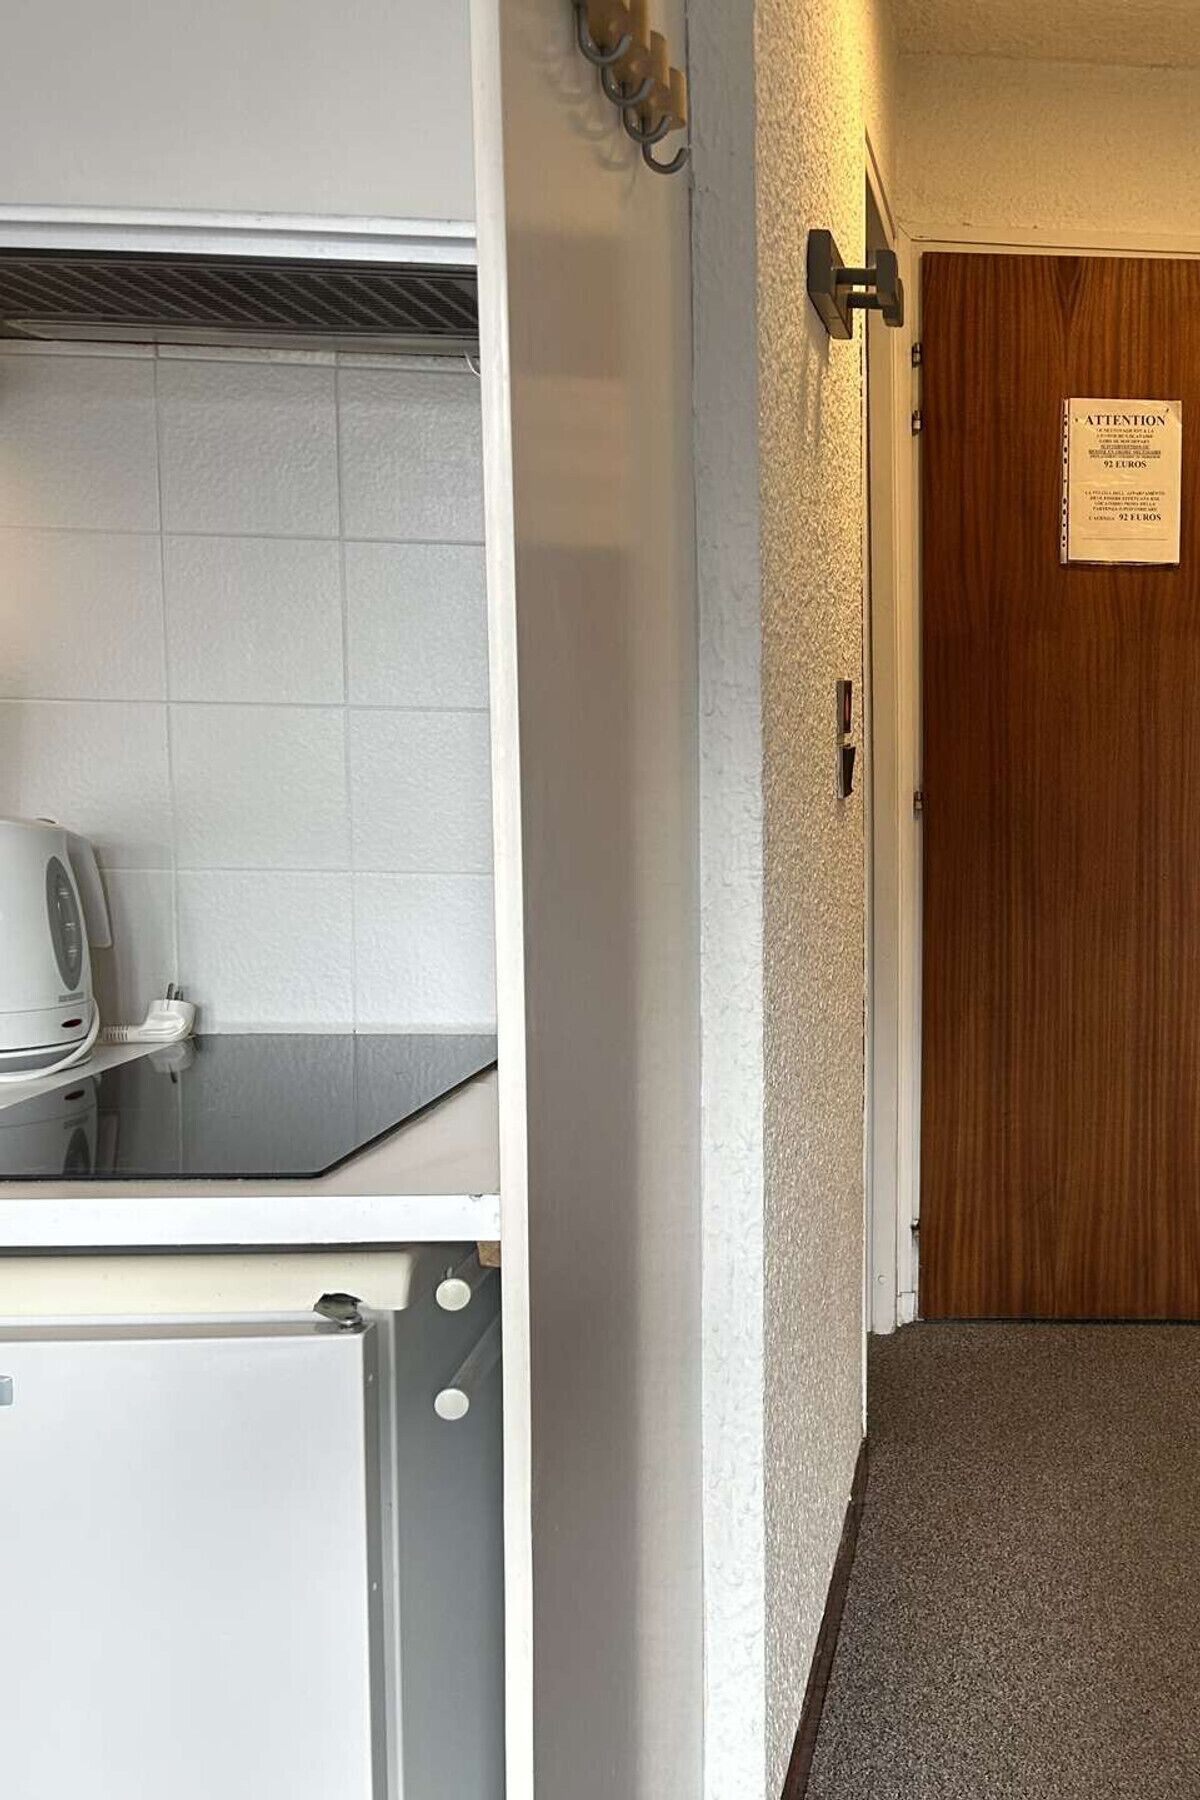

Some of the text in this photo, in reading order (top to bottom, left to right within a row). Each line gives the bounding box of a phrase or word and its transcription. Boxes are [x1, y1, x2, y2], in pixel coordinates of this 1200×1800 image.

[1085, 415, 1165, 426] ATTENTION
[1103, 460, 1147, 468] 92 EUROS
[1118, 513, 1128, 521] 92
[1130, 513, 1161, 521] EUROS
